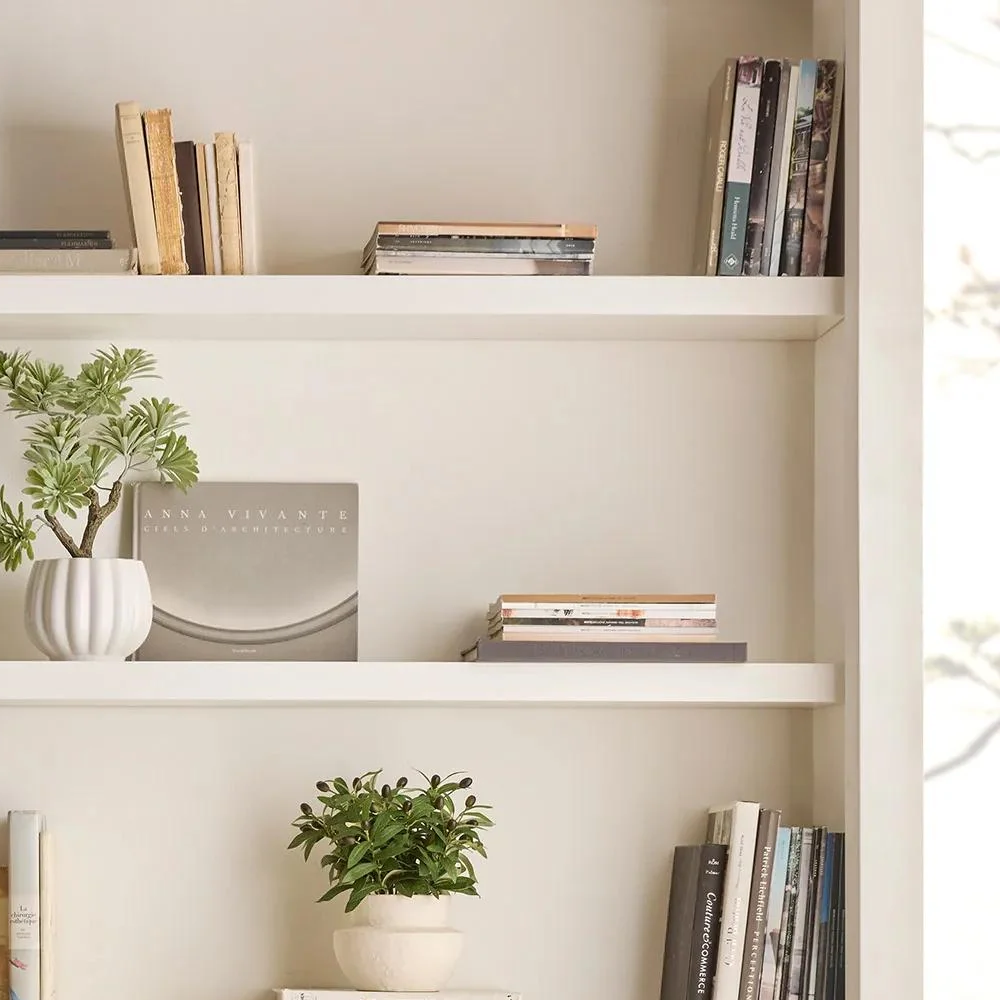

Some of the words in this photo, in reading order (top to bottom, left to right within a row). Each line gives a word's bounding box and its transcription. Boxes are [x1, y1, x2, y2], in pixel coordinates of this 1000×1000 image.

[144, 509, 207, 519] ANNA
[228, 509, 348, 520] VIVANTE
[201, 526, 348, 534] D'ARCHITECTURE
[760, 846, 772, 880] Patrick
[755, 880, 769, 922] Lichfield
